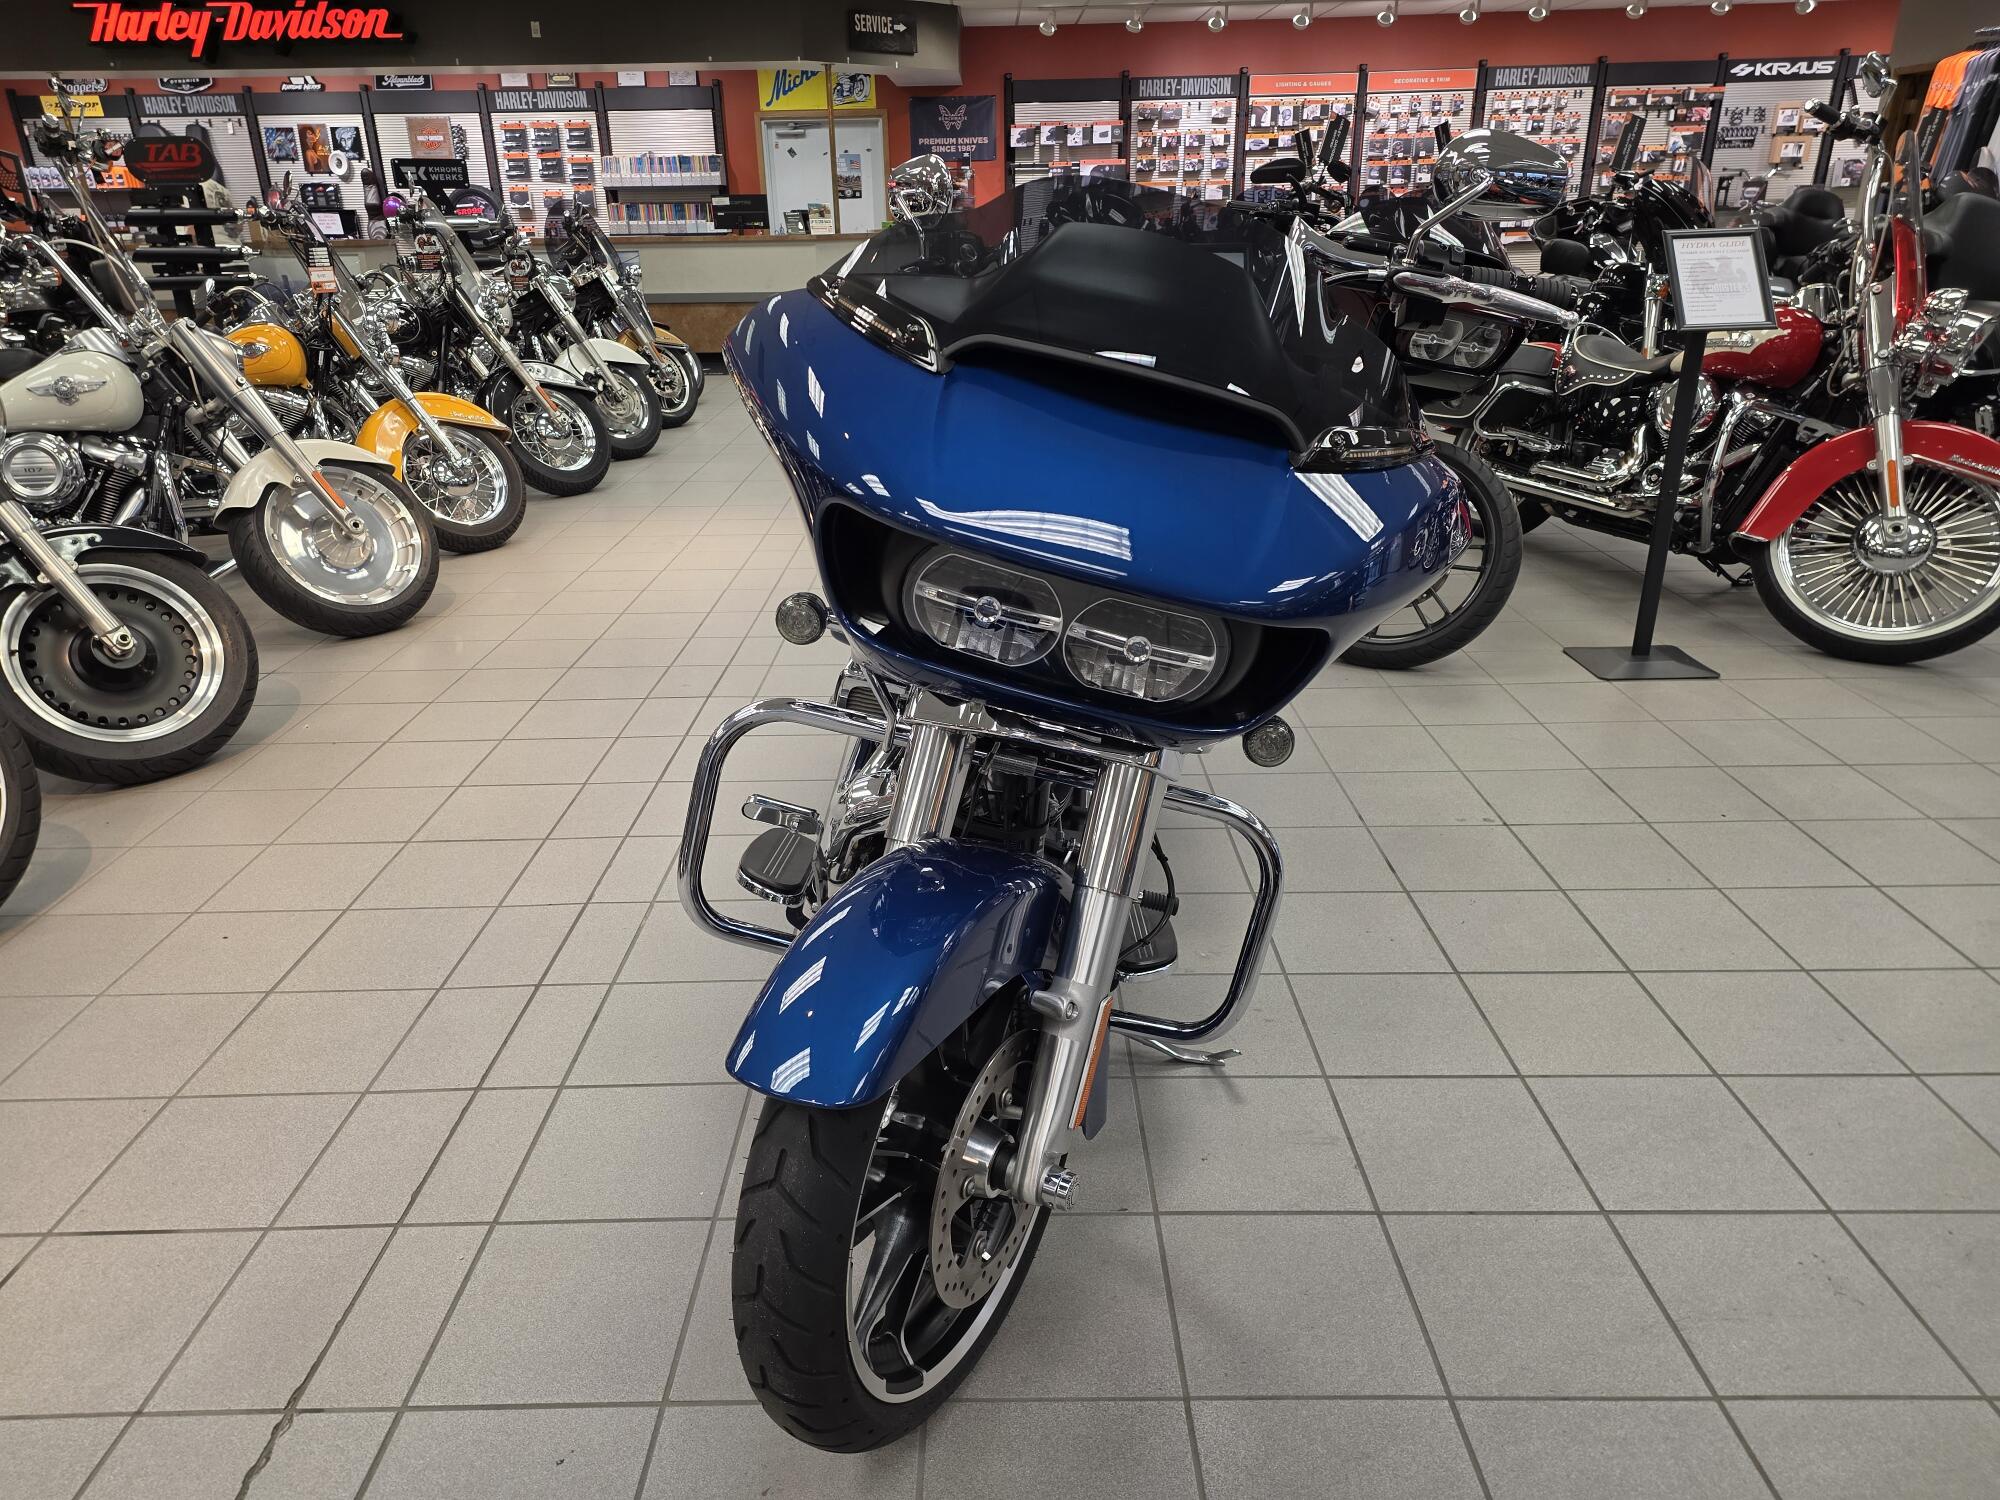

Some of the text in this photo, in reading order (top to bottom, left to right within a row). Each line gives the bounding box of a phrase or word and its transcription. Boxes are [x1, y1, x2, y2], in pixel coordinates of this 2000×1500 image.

[73, 1, 403, 58] Harley-Davidson
[854, 13, 893, 34] SERVICE
[1494, 66, 1590, 87] HARLEY-DAVIDSON
[1754, 60, 1837, 77] KRAUS
[1139, 77, 1232, 97] HARLEY-DAVIDSON
[142, 95, 238, 115] HARLEY-DAVIDSON
[494, 90, 588, 110] HARLEY-DAVIDSON
[918, 136, 989, 145] PREMIUM KNIVES
[931, 145, 956, 153] SINCE
[144, 143, 202, 161] TAB
[431, 173, 464, 181] WERKS
[1681, 240, 1716, 249] HYDRA
